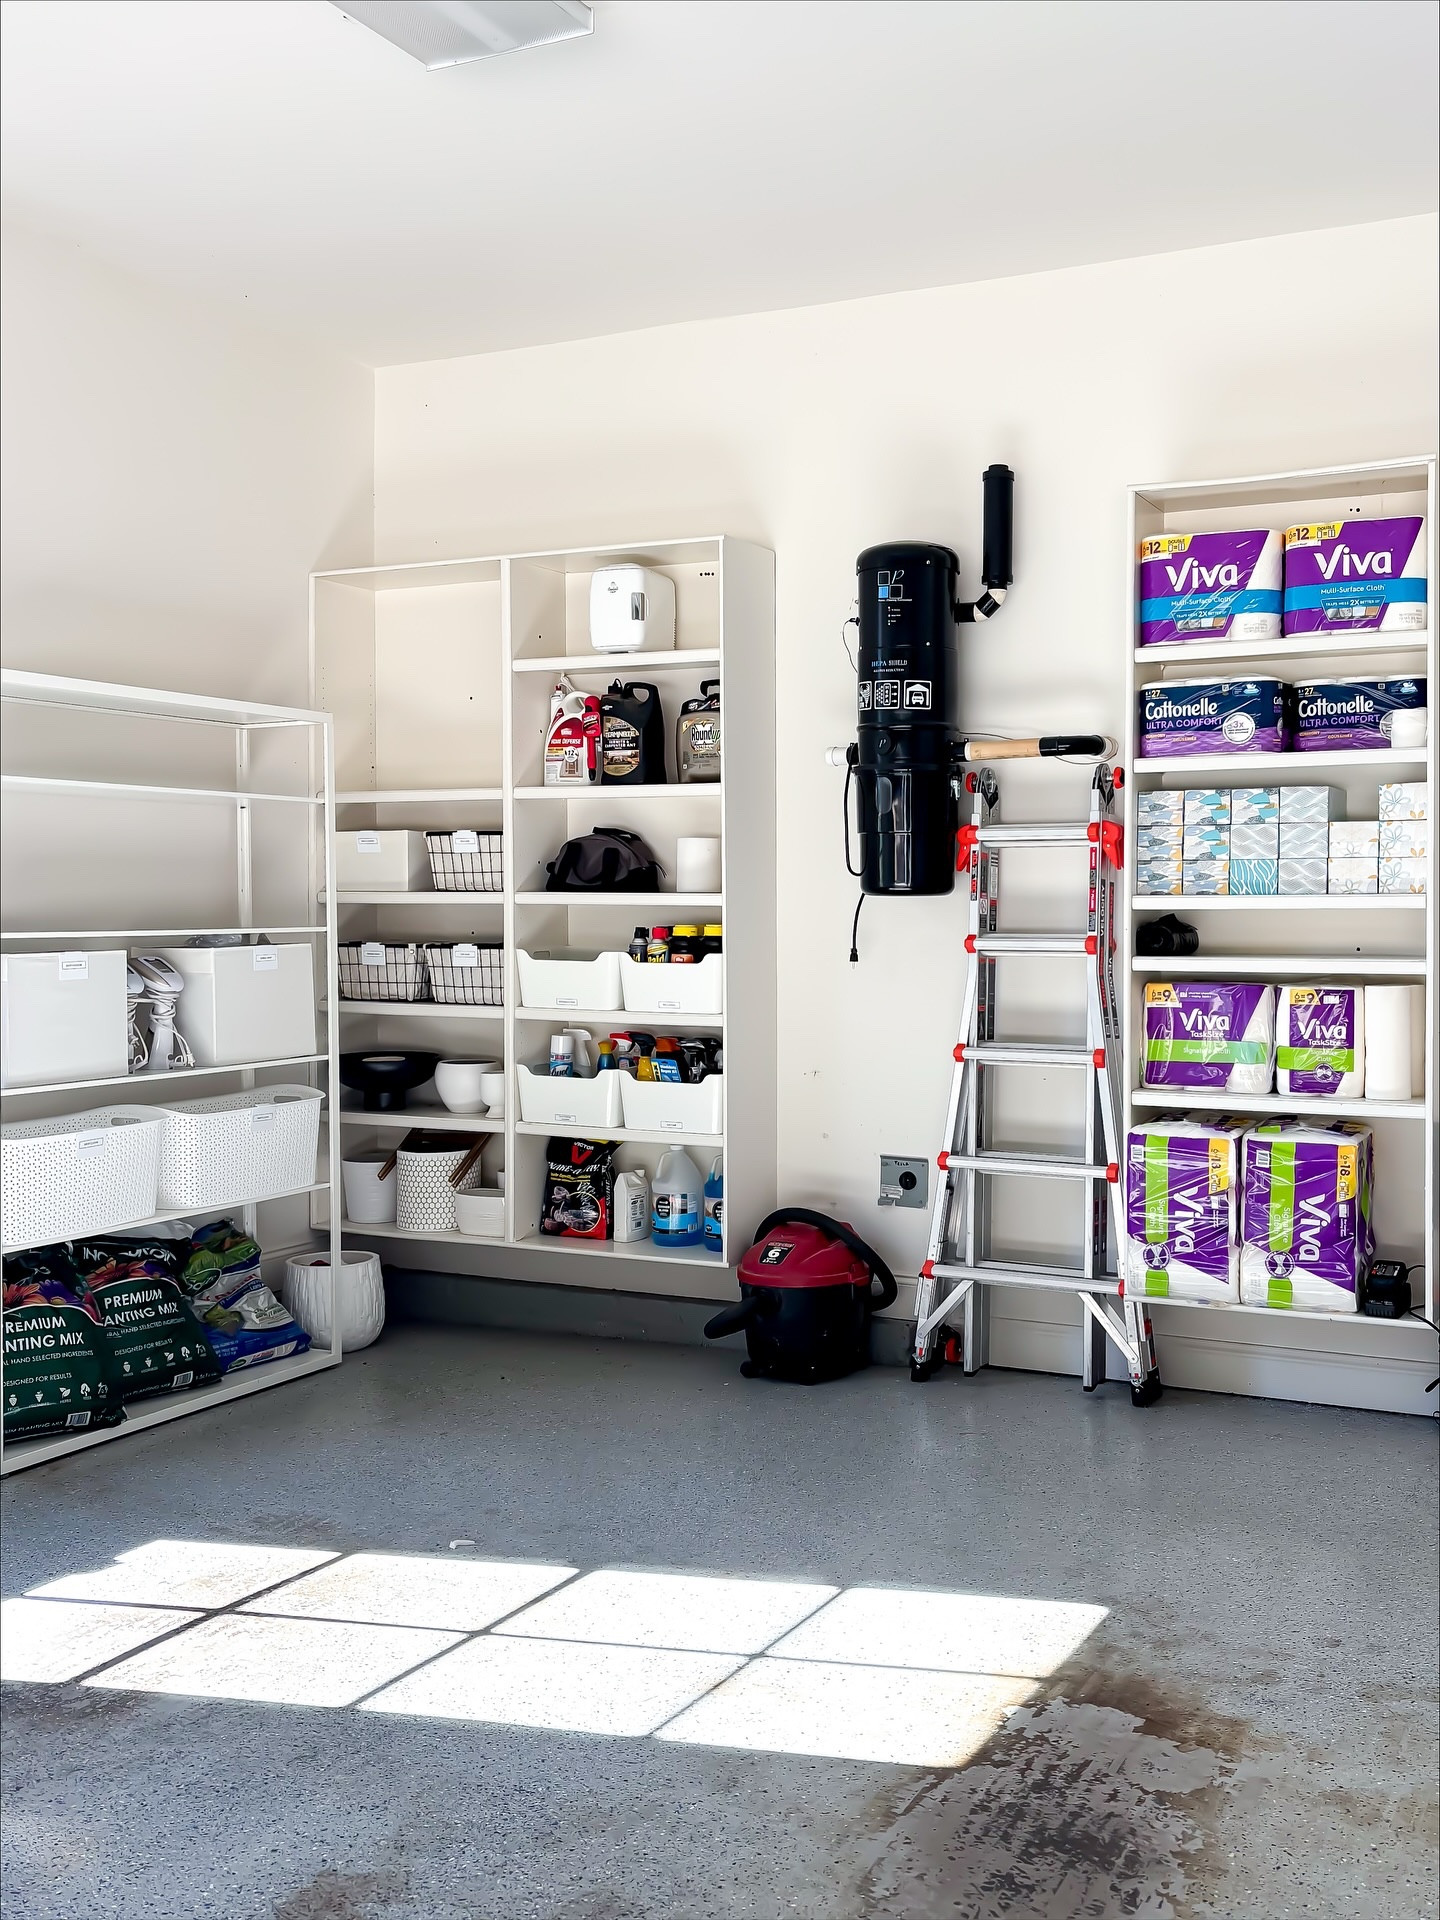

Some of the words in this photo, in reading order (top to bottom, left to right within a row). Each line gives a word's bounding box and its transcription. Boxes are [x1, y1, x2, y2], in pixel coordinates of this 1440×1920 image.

[1313, 544, 1393, 580] Viva
[1164, 557, 1239, 592] Viva
[1320, 586, 1364, 595] Multi-Surface
[1366, 584, 1385, 592] Cloth
[1151, 689, 1161, 698] 27
[1304, 687, 1314, 695] 27
[1145, 697, 1218, 720] Cottonelle
[1298, 695, 1374, 718] Cottonelle
[1146, 720, 1174, 730] ULTRA
[1175, 716, 1223, 728] COMFORT
[1300, 718, 1329, 728] ULTRA
[1330, 714, 1381, 725] COMFORT
[691, 727, 720, 742] Roundup
[1108, 957, 1116, 1008] VELOCITY
[1179, 1008, 1230, 1031] Viva
[1190, 1030, 1224, 1038] TaskSize
[1297, 1018, 1347, 1040] Viva
[573, 1141, 594, 1150] VICTOR
[1173, 1186, 1204, 1253] Viva
[1282, 1206, 1291, 1244] Signature
[1298, 1194, 1331, 1262] Viva
[768, 1248, 782, 1258] 6
[104, 1288, 163, 1309] PREMIUM
[101, 1307, 156, 1327] ANTING
[158, 1302, 179, 1316] MIX
[5, 1316, 67, 1334] REMIUM
[120, 1325, 139, 1334] HAND
[138, 1320, 163, 1330] SELECTED
[3, 1334, 56, 1353] NTING
[60, 1332, 84, 1346] MIX
[114, 1344, 144, 1356] DESIGNED
[143, 1342, 155, 1350] FOR
[11, 1356, 31, 1365] HAND
[31, 1352, 62, 1362] SELECTED
[49, 1372, 72, 1381] RESULTS
